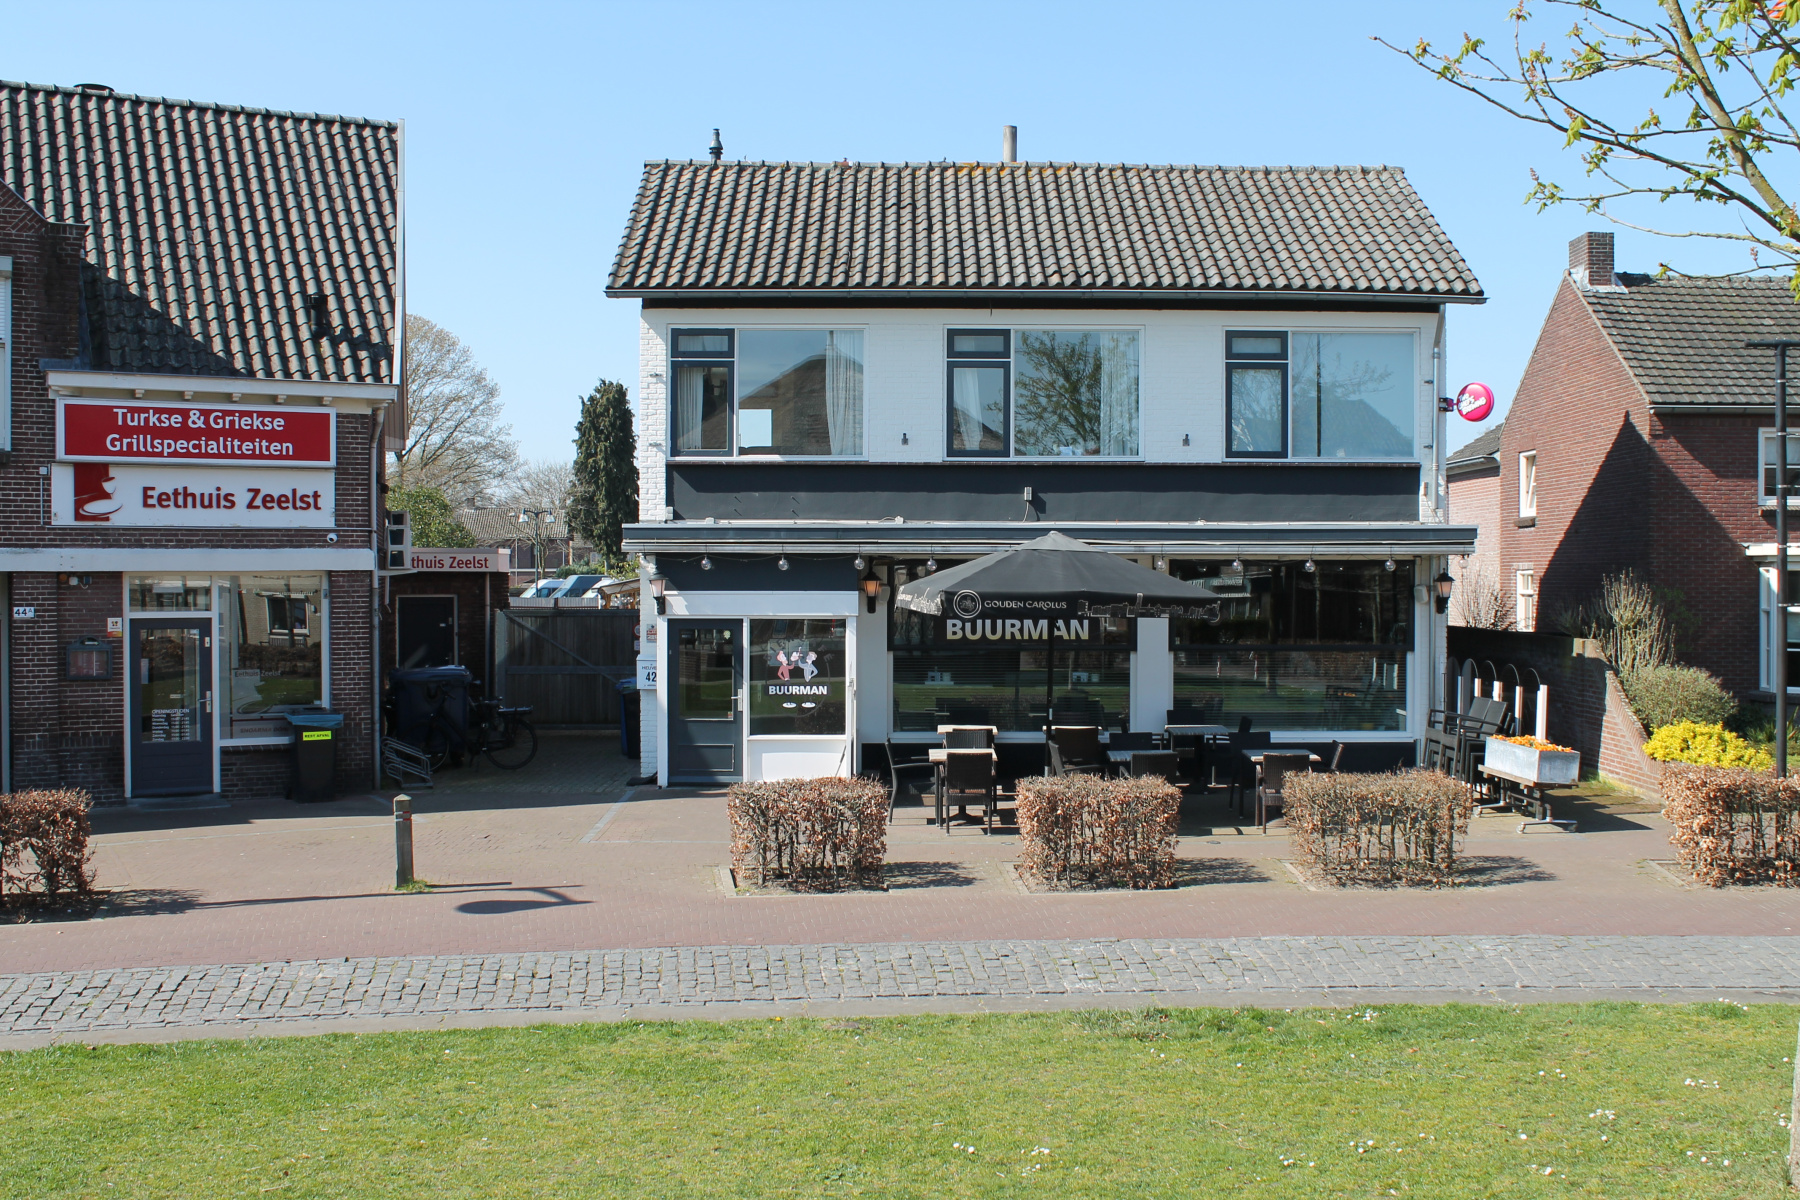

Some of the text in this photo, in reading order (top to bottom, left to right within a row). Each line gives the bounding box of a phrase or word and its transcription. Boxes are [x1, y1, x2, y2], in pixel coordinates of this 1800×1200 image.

[113, 408, 285, 431] Turkse & Griekse
[106, 433, 293, 456] Grillspecialiteiten
[142, 486, 321, 511] Eethuis Zeelst
[411, 555, 489, 569] thuis Zeelst
[984, 600, 1067, 610] GOUDEN CAROLUS
[946, 619, 1089, 640] BUURMAN
[645, 671, 657, 682] 42
[769, 685, 828, 695] BUURMAN
